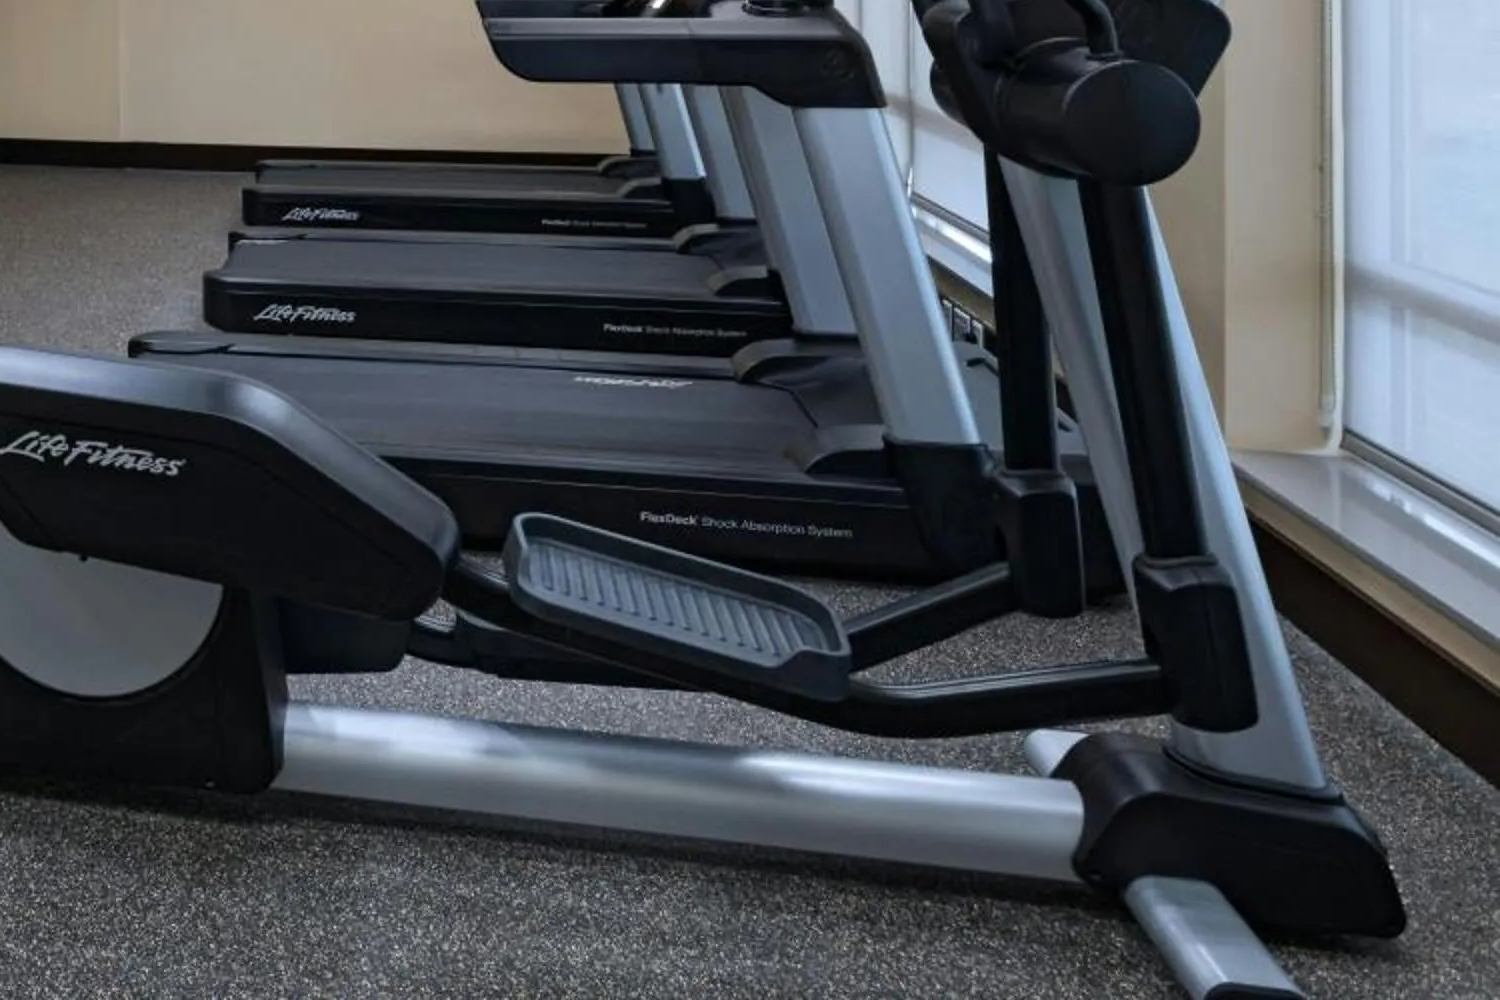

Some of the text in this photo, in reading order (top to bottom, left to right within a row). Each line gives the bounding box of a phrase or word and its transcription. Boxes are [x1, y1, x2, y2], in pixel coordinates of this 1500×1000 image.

[701, 515, 739, 530] Shock
[741, 519, 805, 536] Absorption
[807, 525, 853, 539] System
